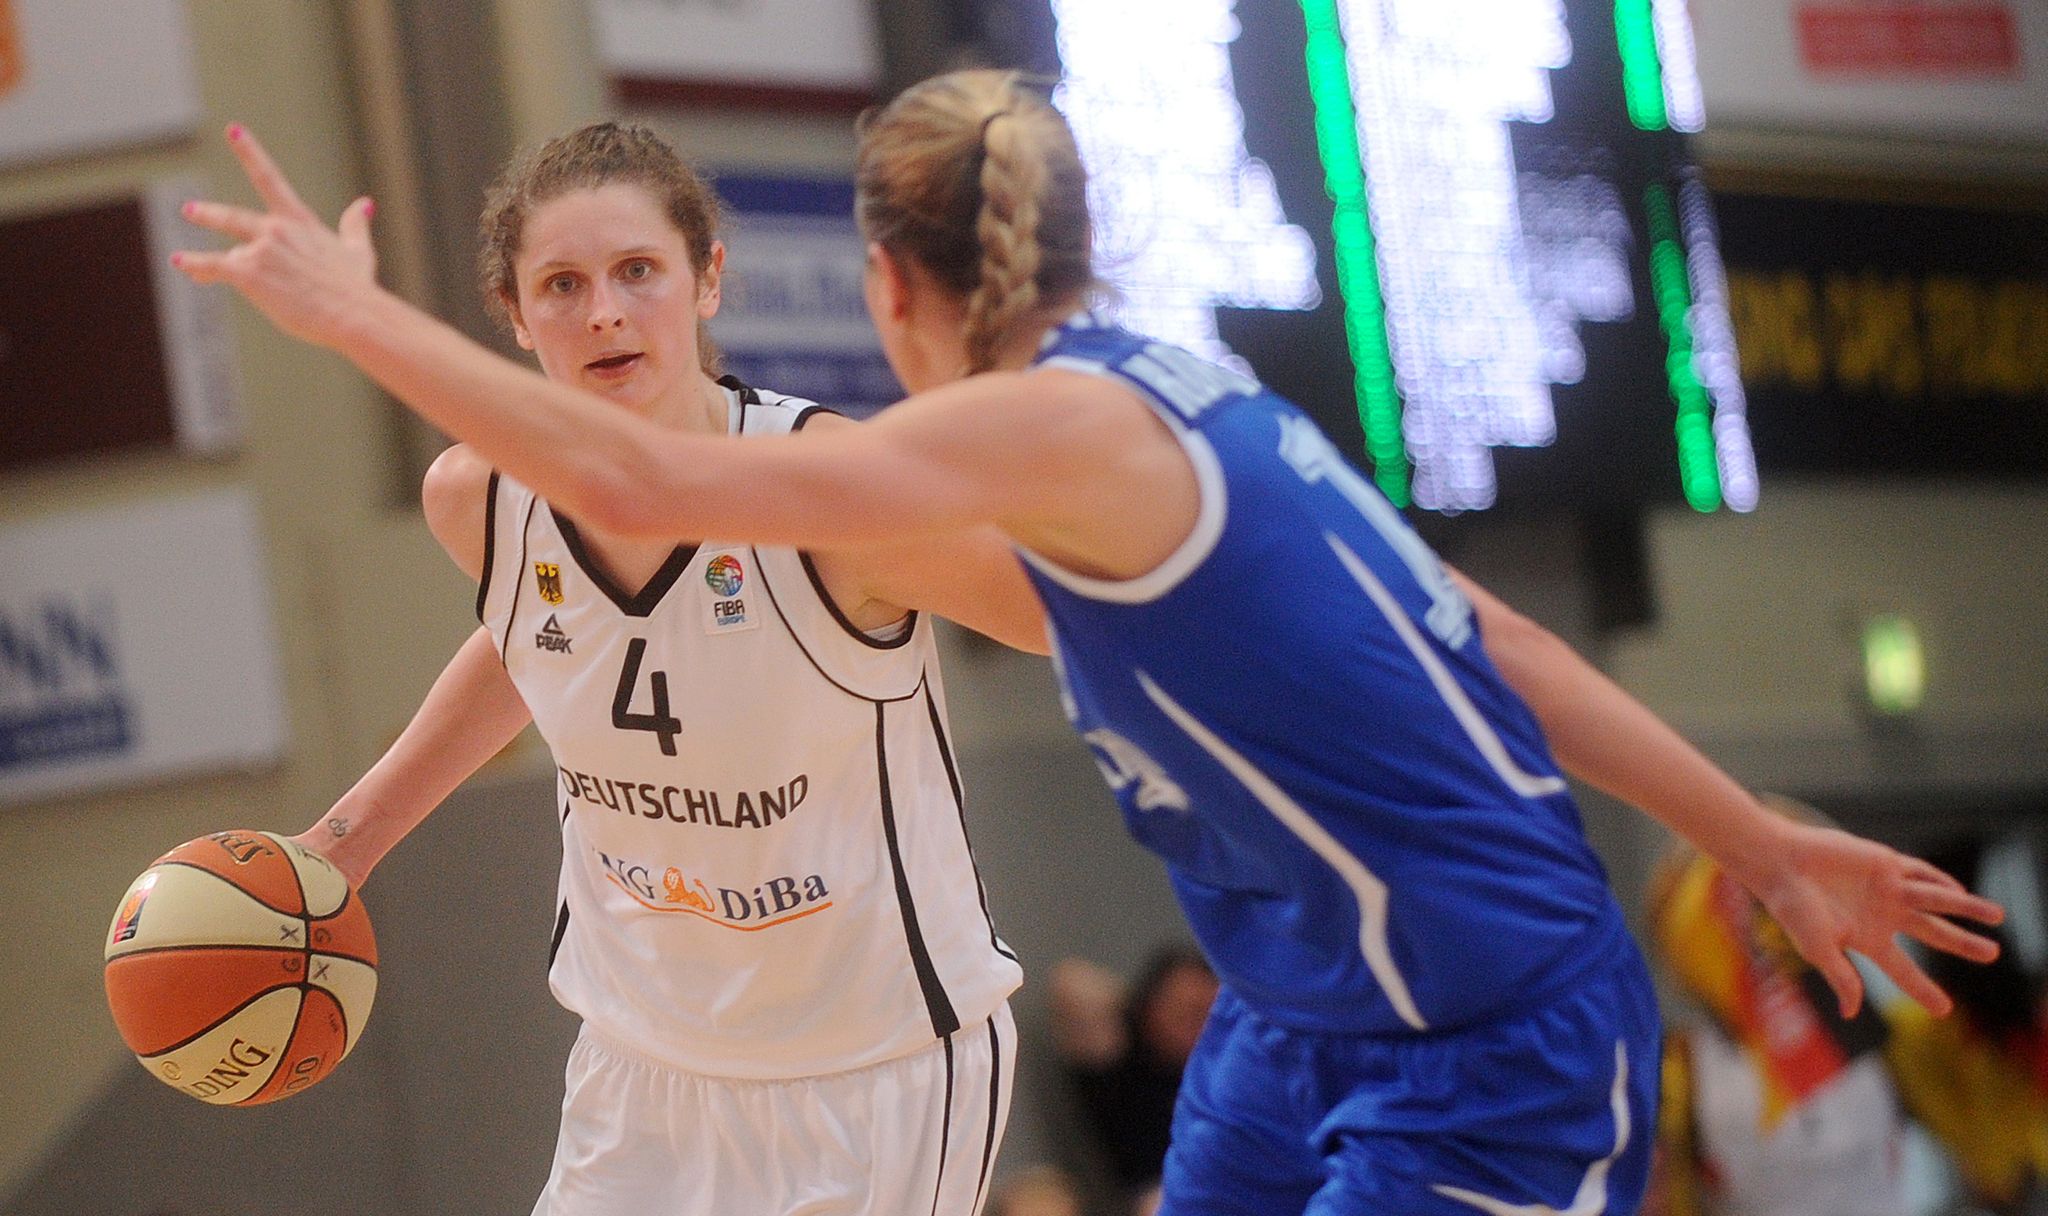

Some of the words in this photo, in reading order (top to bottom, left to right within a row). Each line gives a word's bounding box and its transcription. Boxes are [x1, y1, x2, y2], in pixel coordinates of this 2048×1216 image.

[714, 599, 745, 617] FIBA
[535, 633, 573, 655] PEAK
[612, 637, 682, 756] 4
[560, 766, 809, 829] DEUTSCHLAND
[598, 850, 655, 899] NG
[718, 874, 829, 921] DiBa
